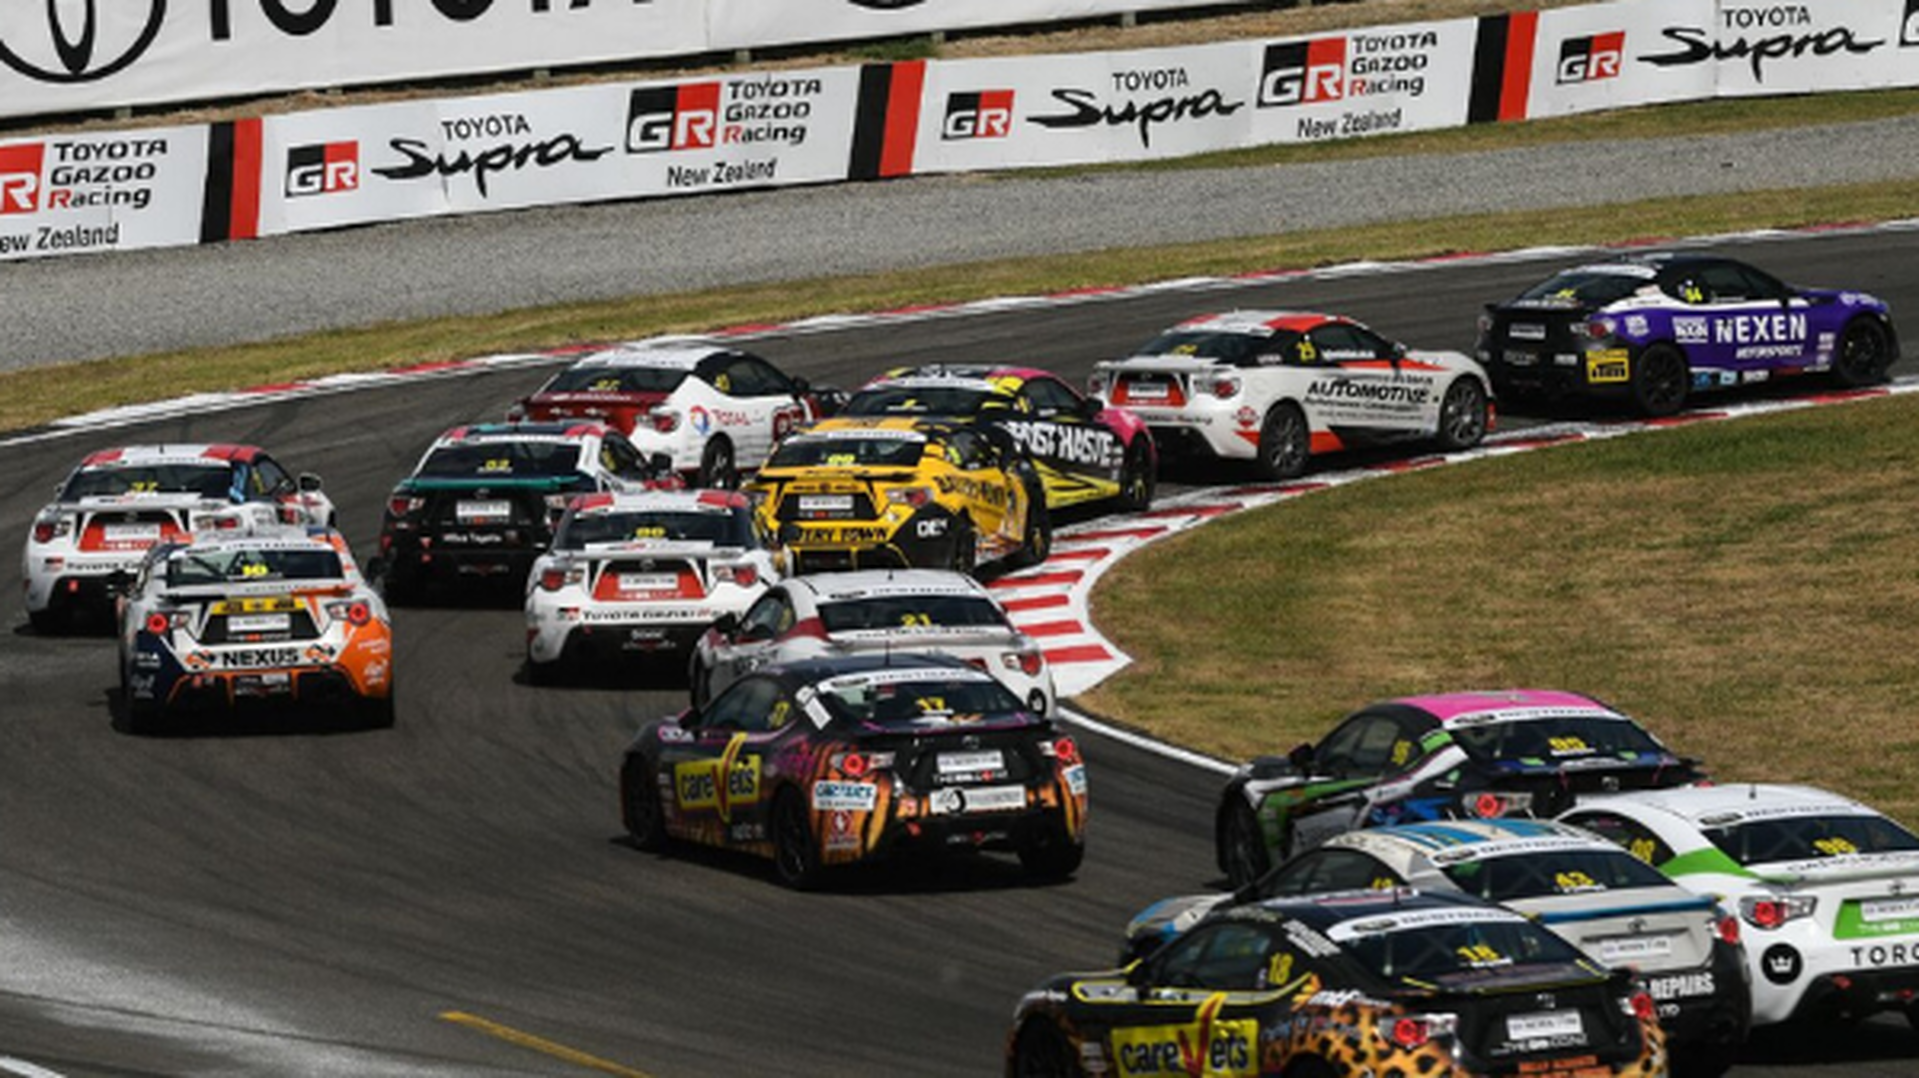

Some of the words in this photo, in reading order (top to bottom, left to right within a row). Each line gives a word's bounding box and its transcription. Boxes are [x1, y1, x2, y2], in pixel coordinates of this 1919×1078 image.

[1723, 6, 1811, 28] TOYOTA
[1353, 31, 1438, 54] TOYOTA
[1636, 26, 1886, 84] Supra
[1350, 54, 1428, 75] GAZOO
[1560, 49, 1622, 81] GR
[727, 78, 822, 100] TOYOTA
[1112, 67, 1188, 91] TOYOTA
[1261, 63, 1342, 103] GR
[1349, 75, 1425, 97] Racing
[725, 101, 811, 122] GAZOO
[945, 108, 1010, 138] GR
[1026, 88, 1245, 149] Supra
[1297, 117, 1338, 139] New
[1341, 108, 1403, 135] Zealand
[441, 114, 531, 141] TOYOTA
[630, 110, 715, 149] GR
[722, 121, 807, 145] Racing
[53, 139, 167, 163] TOYOTA
[50, 162, 156, 187] GAZOO
[288, 156, 357, 195] GR
[370, 133, 615, 198] Supra
[667, 165, 711, 189] New
[713, 157, 777, 185] Zealand
[0, 171, 37, 209] R
[48, 184, 151, 210] Racing
[0, 234, 30, 254] ew
[36, 222, 120, 250] Zealand
[1716, 313, 1806, 343] NEXEN
[1307, 377, 1430, 404] AUTOMOTIVE
[711, 408, 752, 426] TOTAL
[221, 648, 300, 668] NEXUS
[1267, 952, 1295, 985] 18
[1650, 972, 1716, 999] REPAIRS
